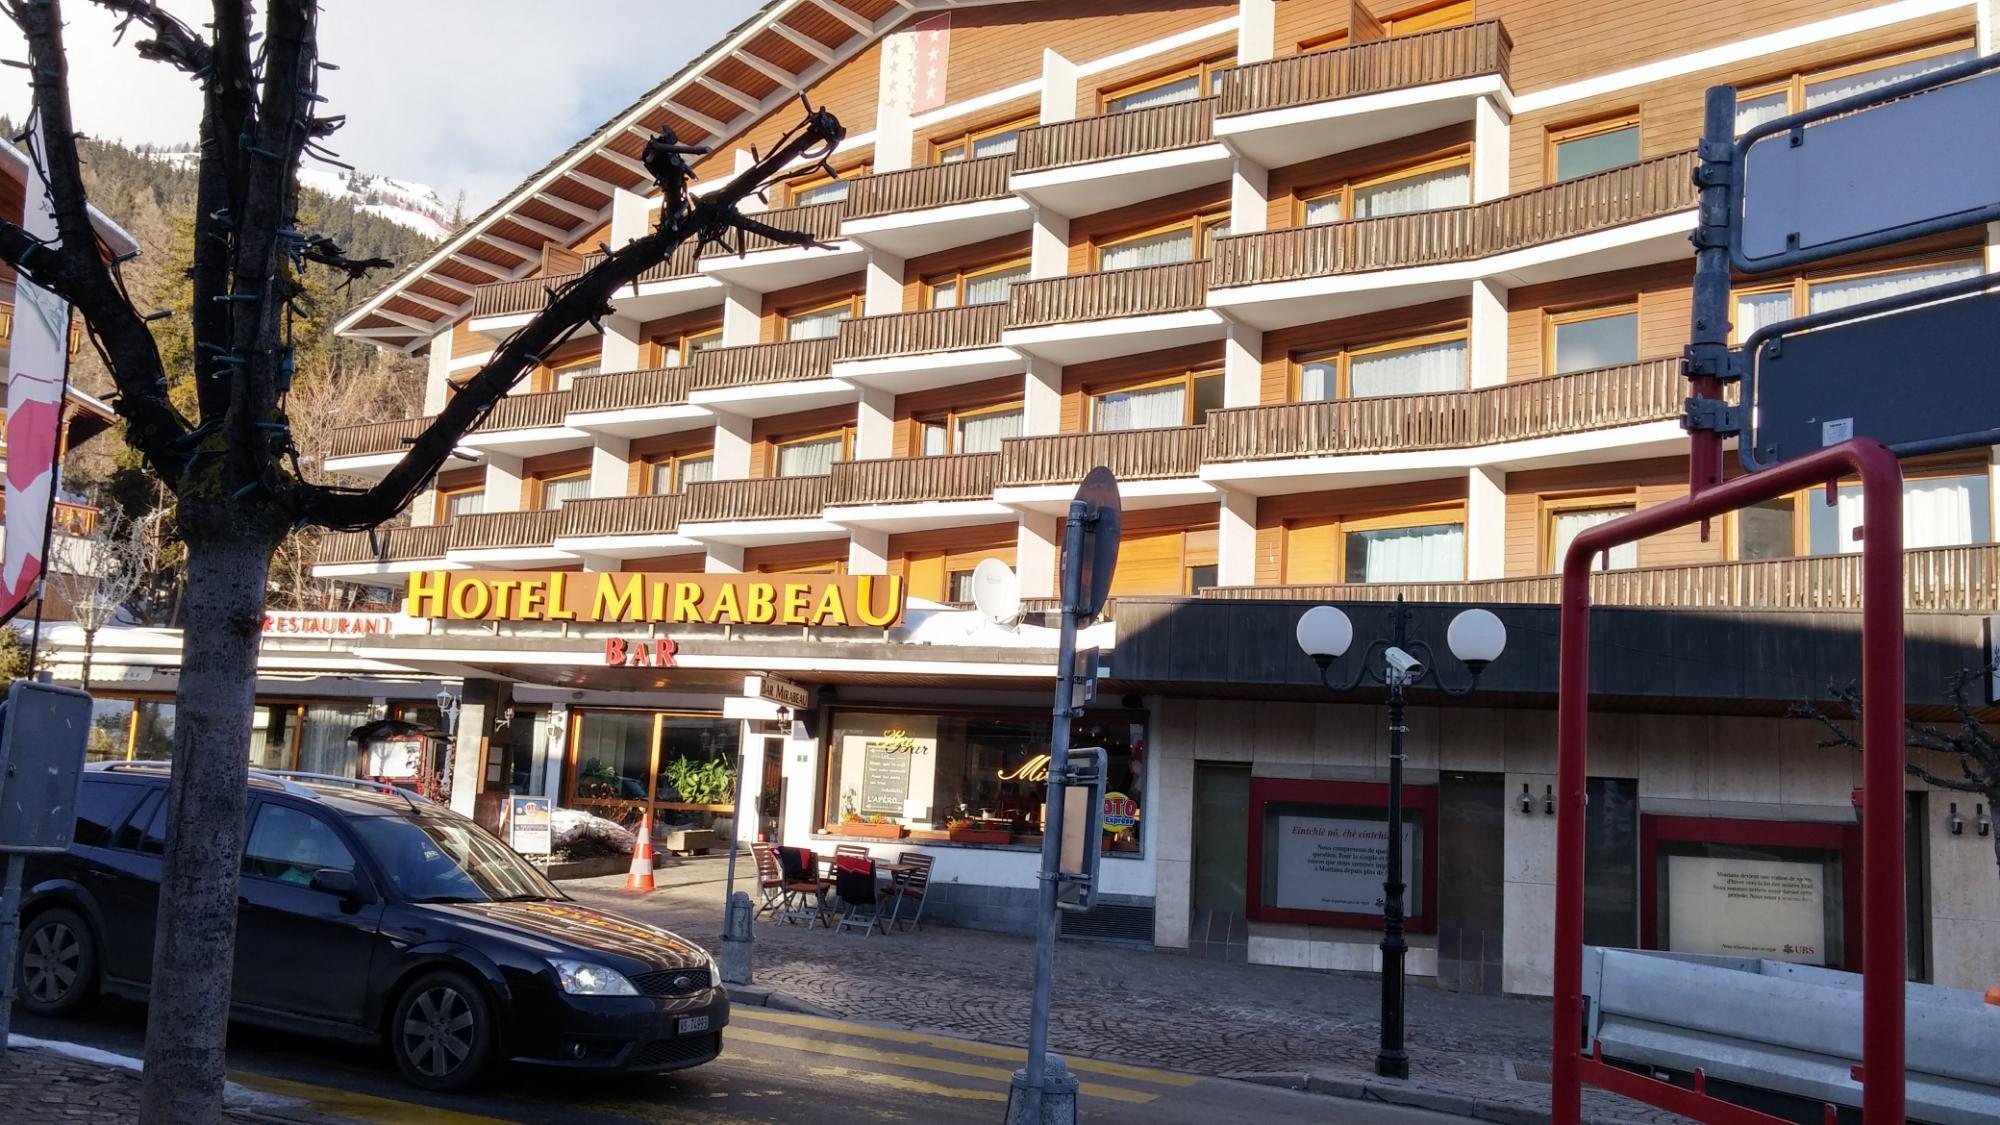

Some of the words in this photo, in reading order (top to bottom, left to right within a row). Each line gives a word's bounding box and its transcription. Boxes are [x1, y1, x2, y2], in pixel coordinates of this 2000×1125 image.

[407, 571, 576, 620] HOTEL
[591, 572, 902, 627] MIRABEAU
[605, 637, 678, 667] BAR
[775, 684, 809, 706] MIRABEAU
[1105, 816, 1134, 827] Express
[1795, 943, 1815, 956] UBS
